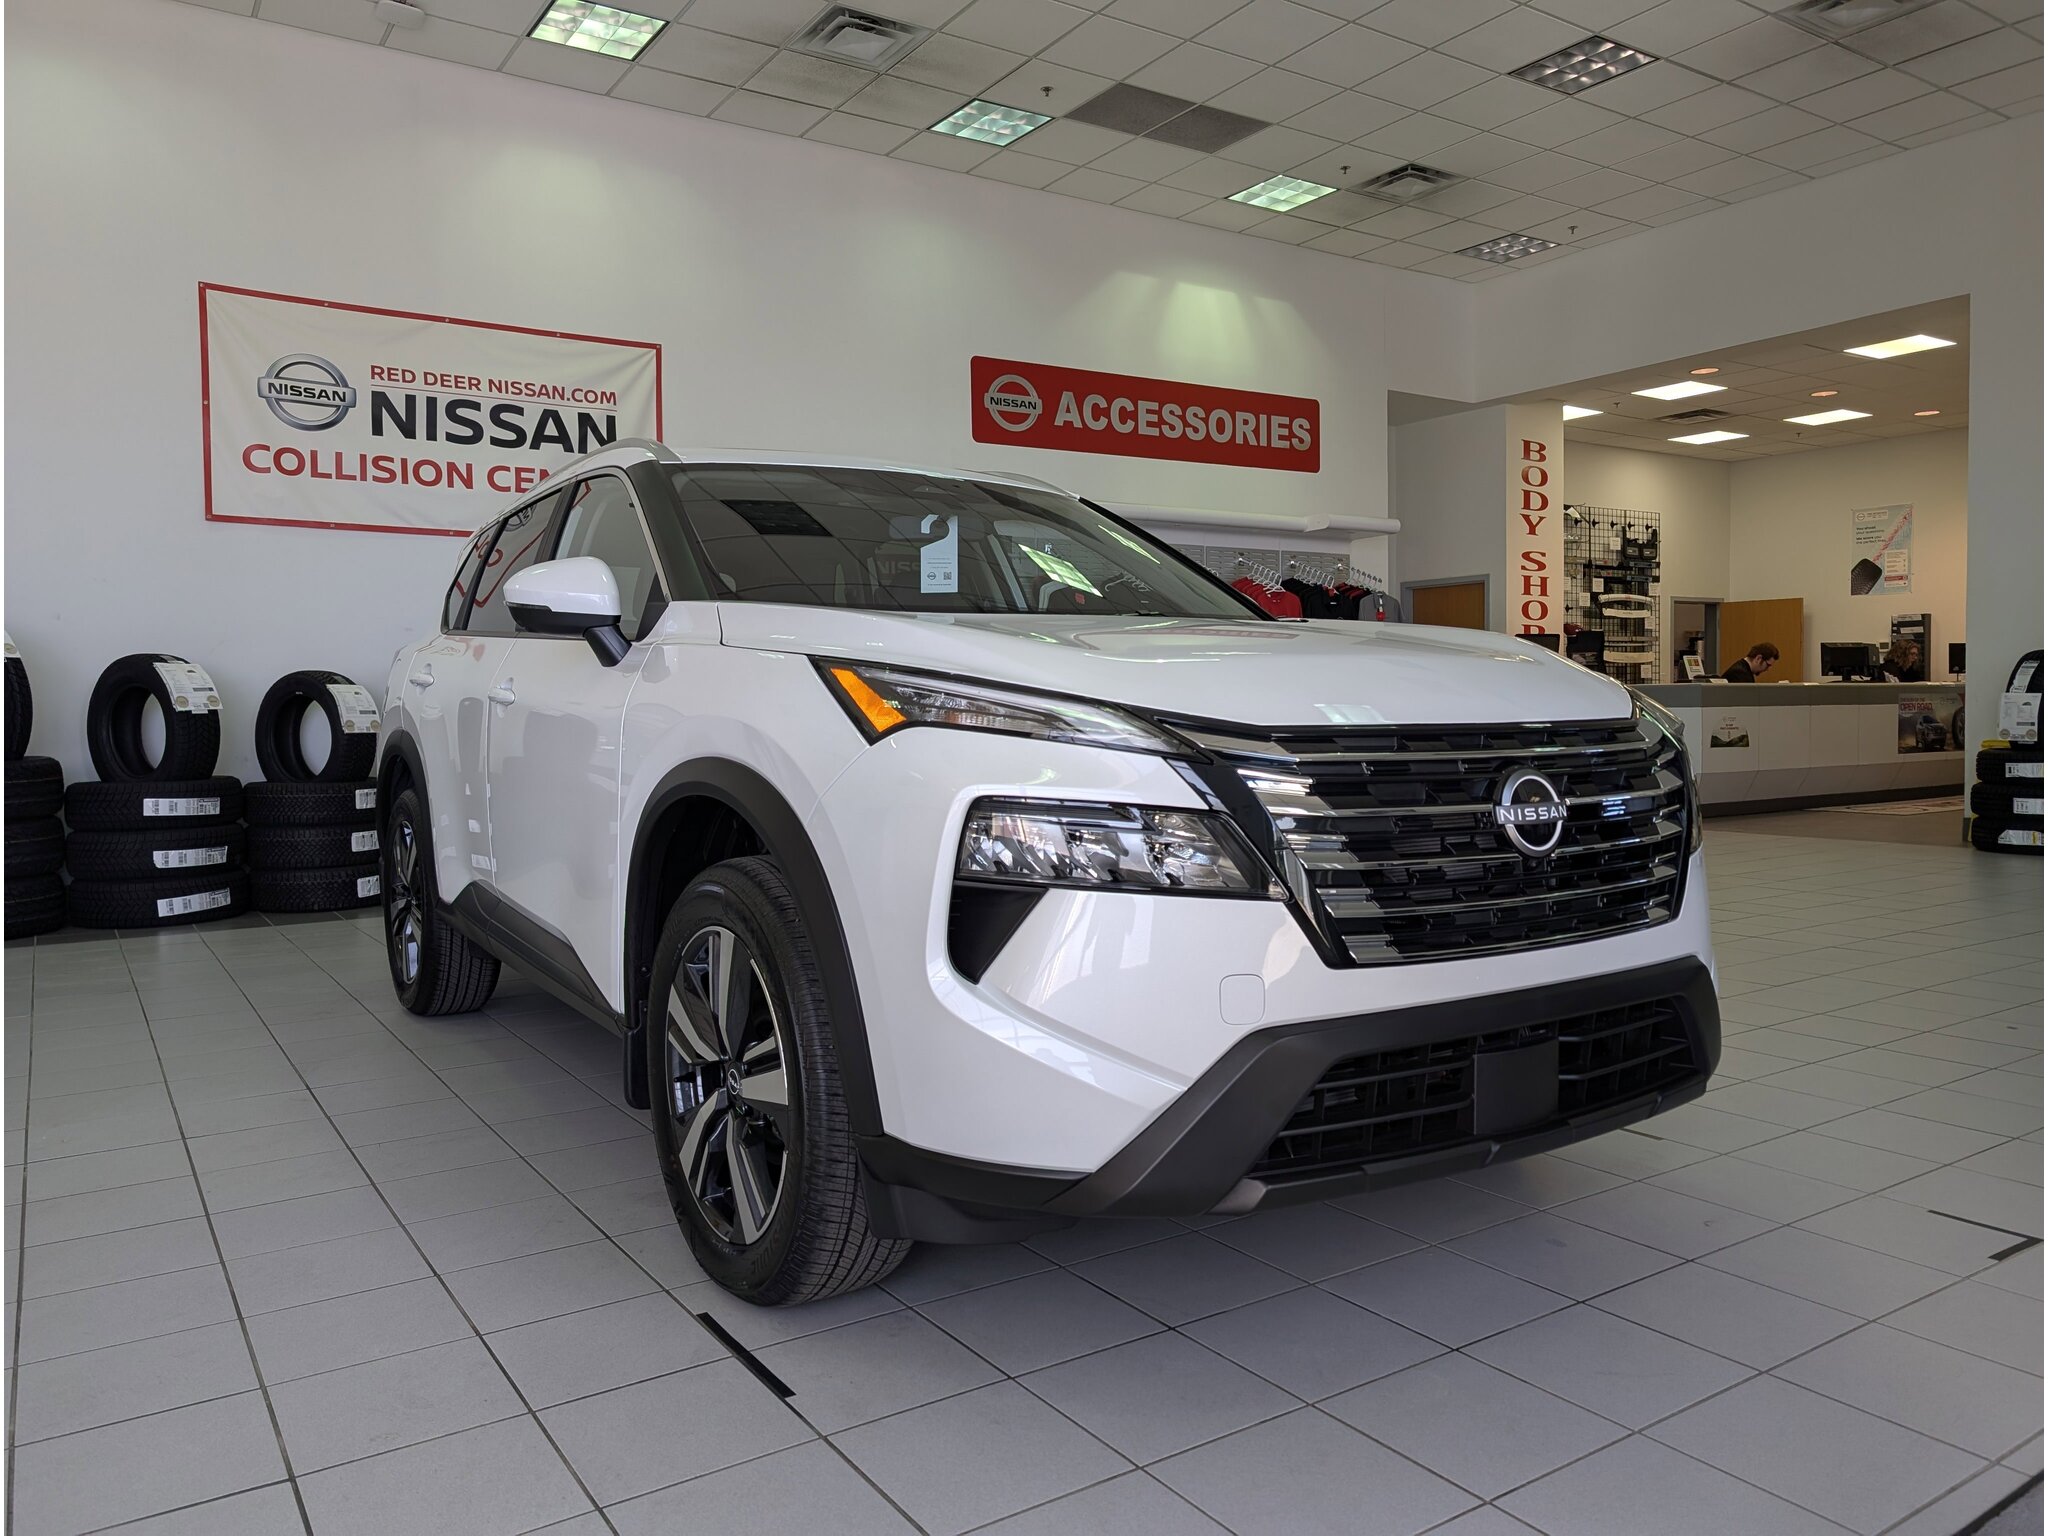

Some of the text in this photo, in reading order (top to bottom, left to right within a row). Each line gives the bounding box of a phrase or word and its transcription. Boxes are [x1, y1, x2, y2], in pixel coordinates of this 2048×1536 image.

[267, 381, 348, 402] NISSAN
[370, 364, 618, 406] RED DEER NISSAN.COM
[989, 396, 1038, 411] NISSAN
[370, 390, 617, 455] NISSAN
[1053, 390, 1312, 451] ACCESSORIES
[241, 443, 552, 494] COLLISION CE
[1519, 438, 1550, 537] BODY
[1499, 805, 1568, 822] NISSAN
